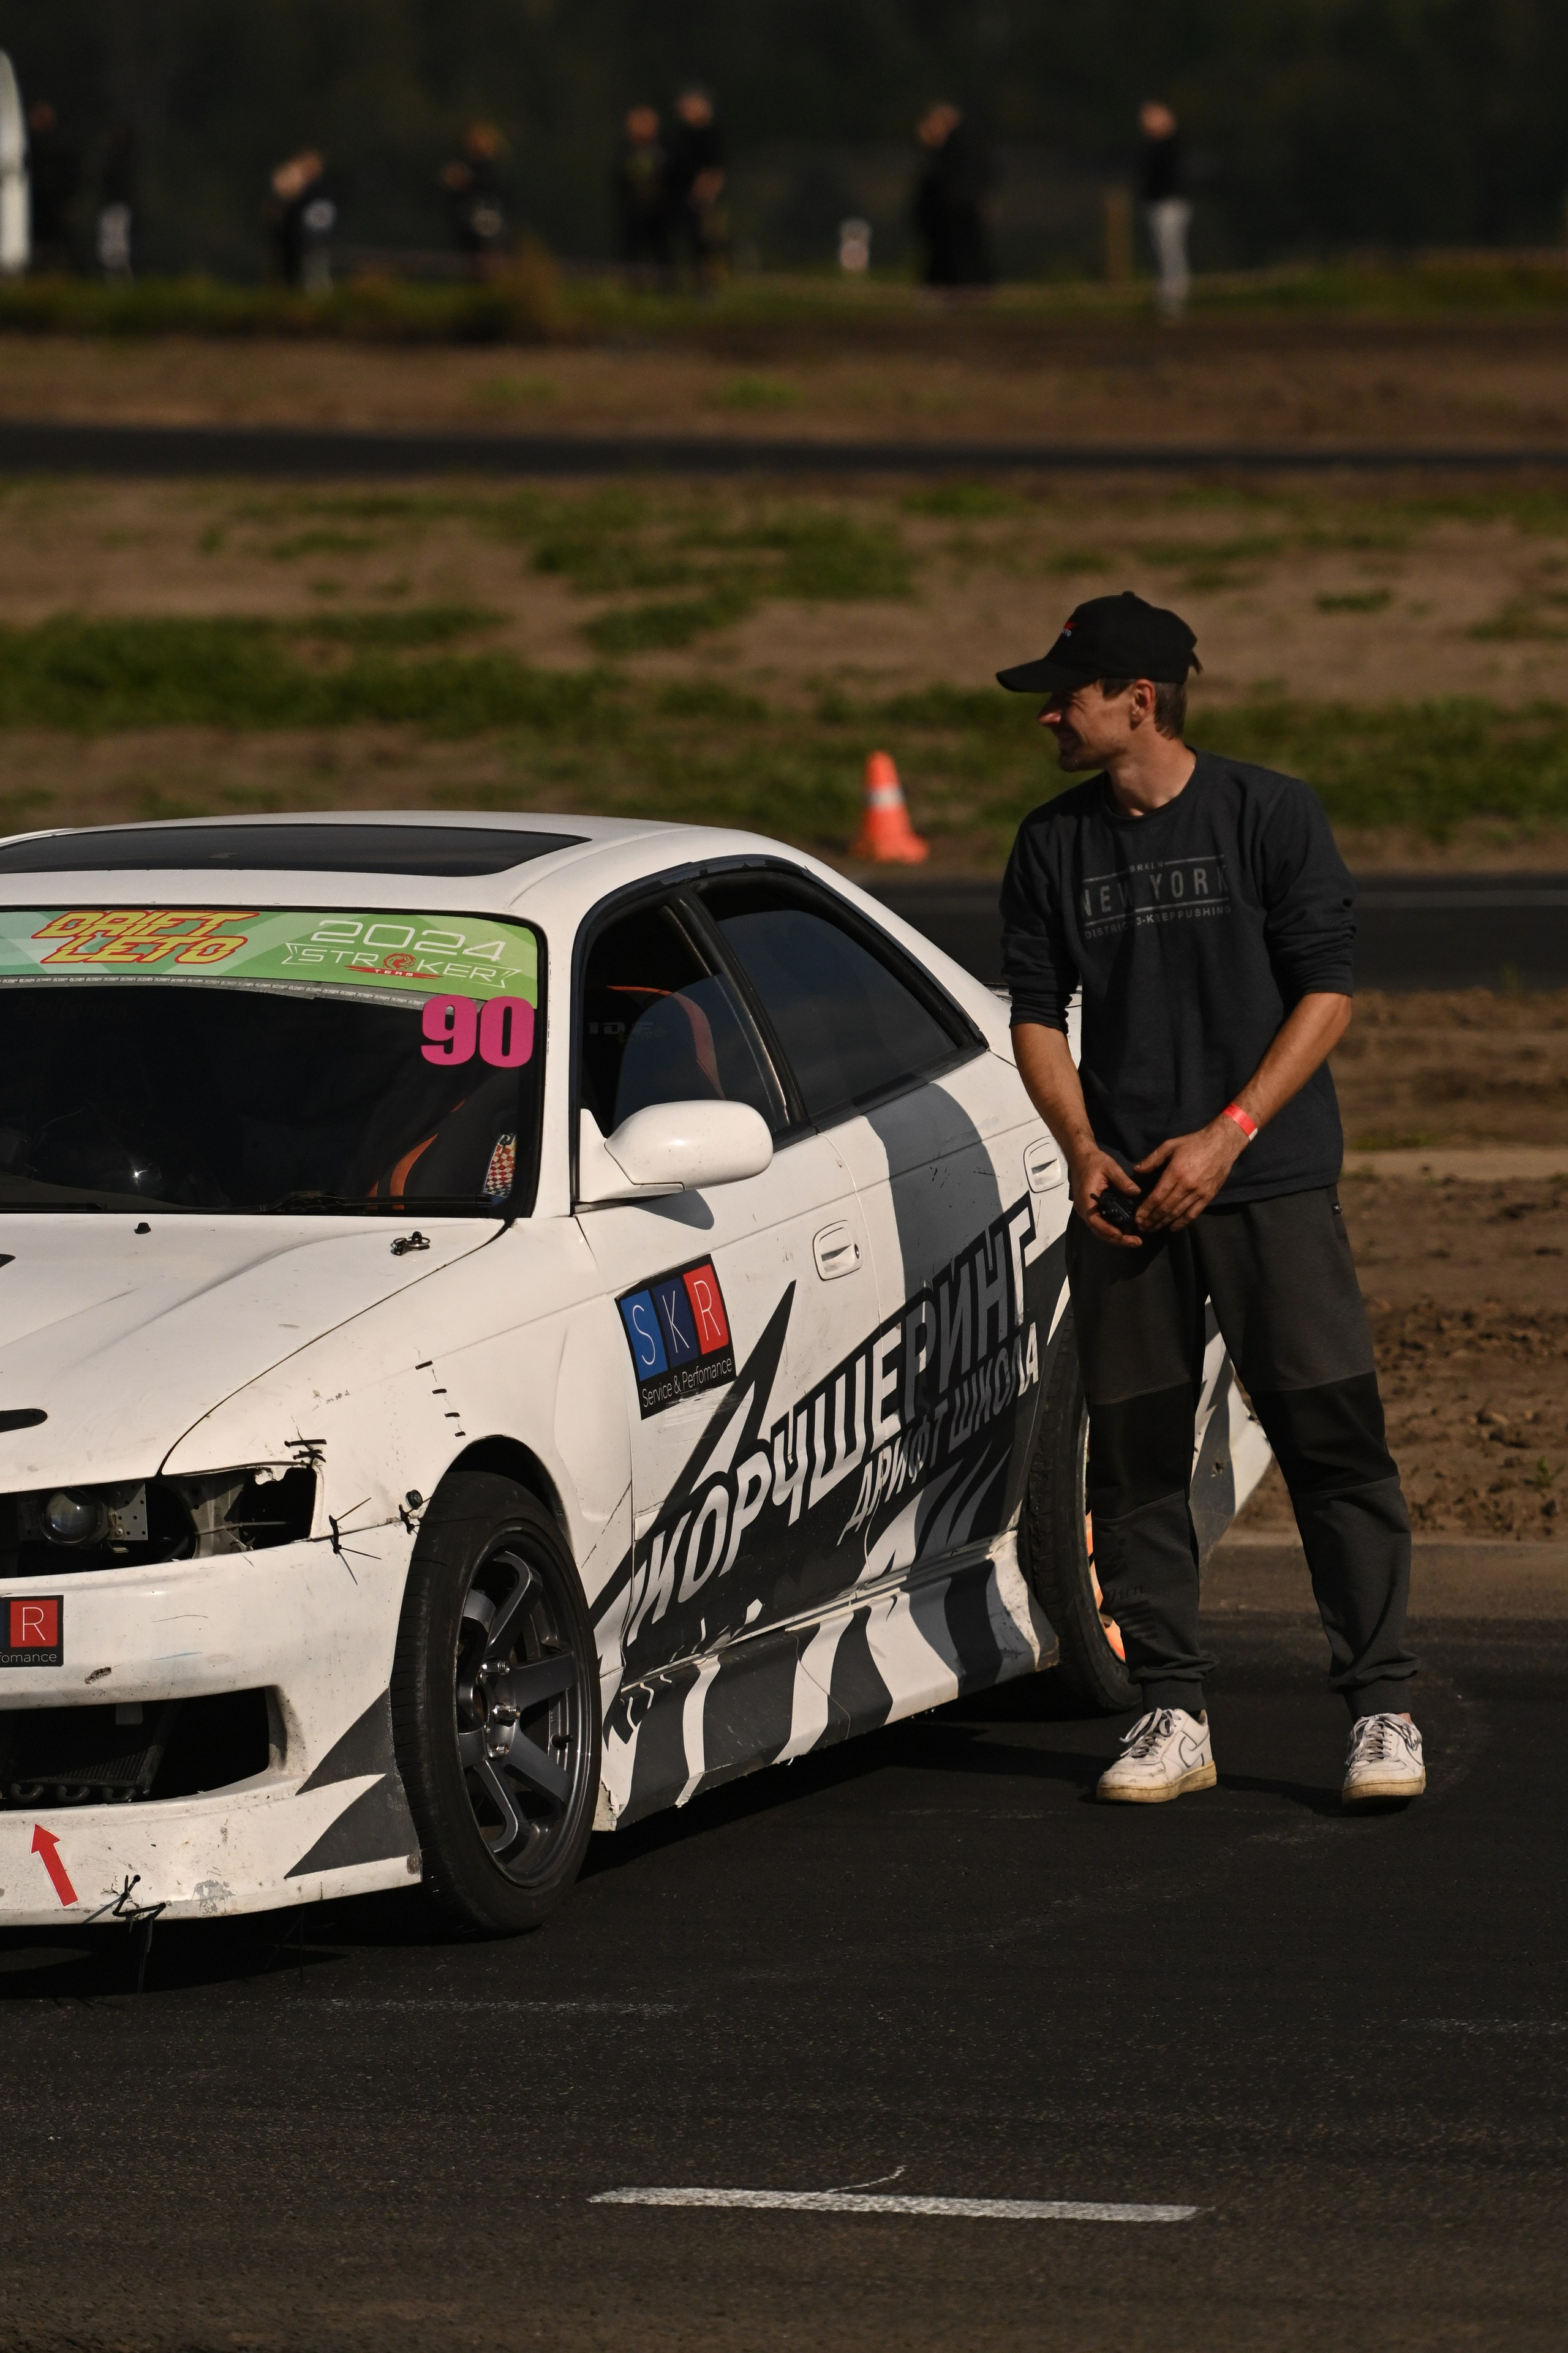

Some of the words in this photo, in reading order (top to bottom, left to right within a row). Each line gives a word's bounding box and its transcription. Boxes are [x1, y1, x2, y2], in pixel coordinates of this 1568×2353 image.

[31, 910, 260, 939] DRIFT
[311, 920, 507, 961] 2024
[40, 935, 248, 964] LETO
[374, 968, 414, 977] TEAM
[421, 994, 535, 1068] 90
[633, 1279, 721, 1365] SKR
[642, 1382, 673, 1407] Service
[673, 1375, 682, 1394] &
[682, 1357, 733, 1391] Perfomance
[837, 1398, 948, 1546] ДРИФТ
[948, 1322, 1039, 1454] ШКОЛА
[23, 1606, 46, 1641] R
